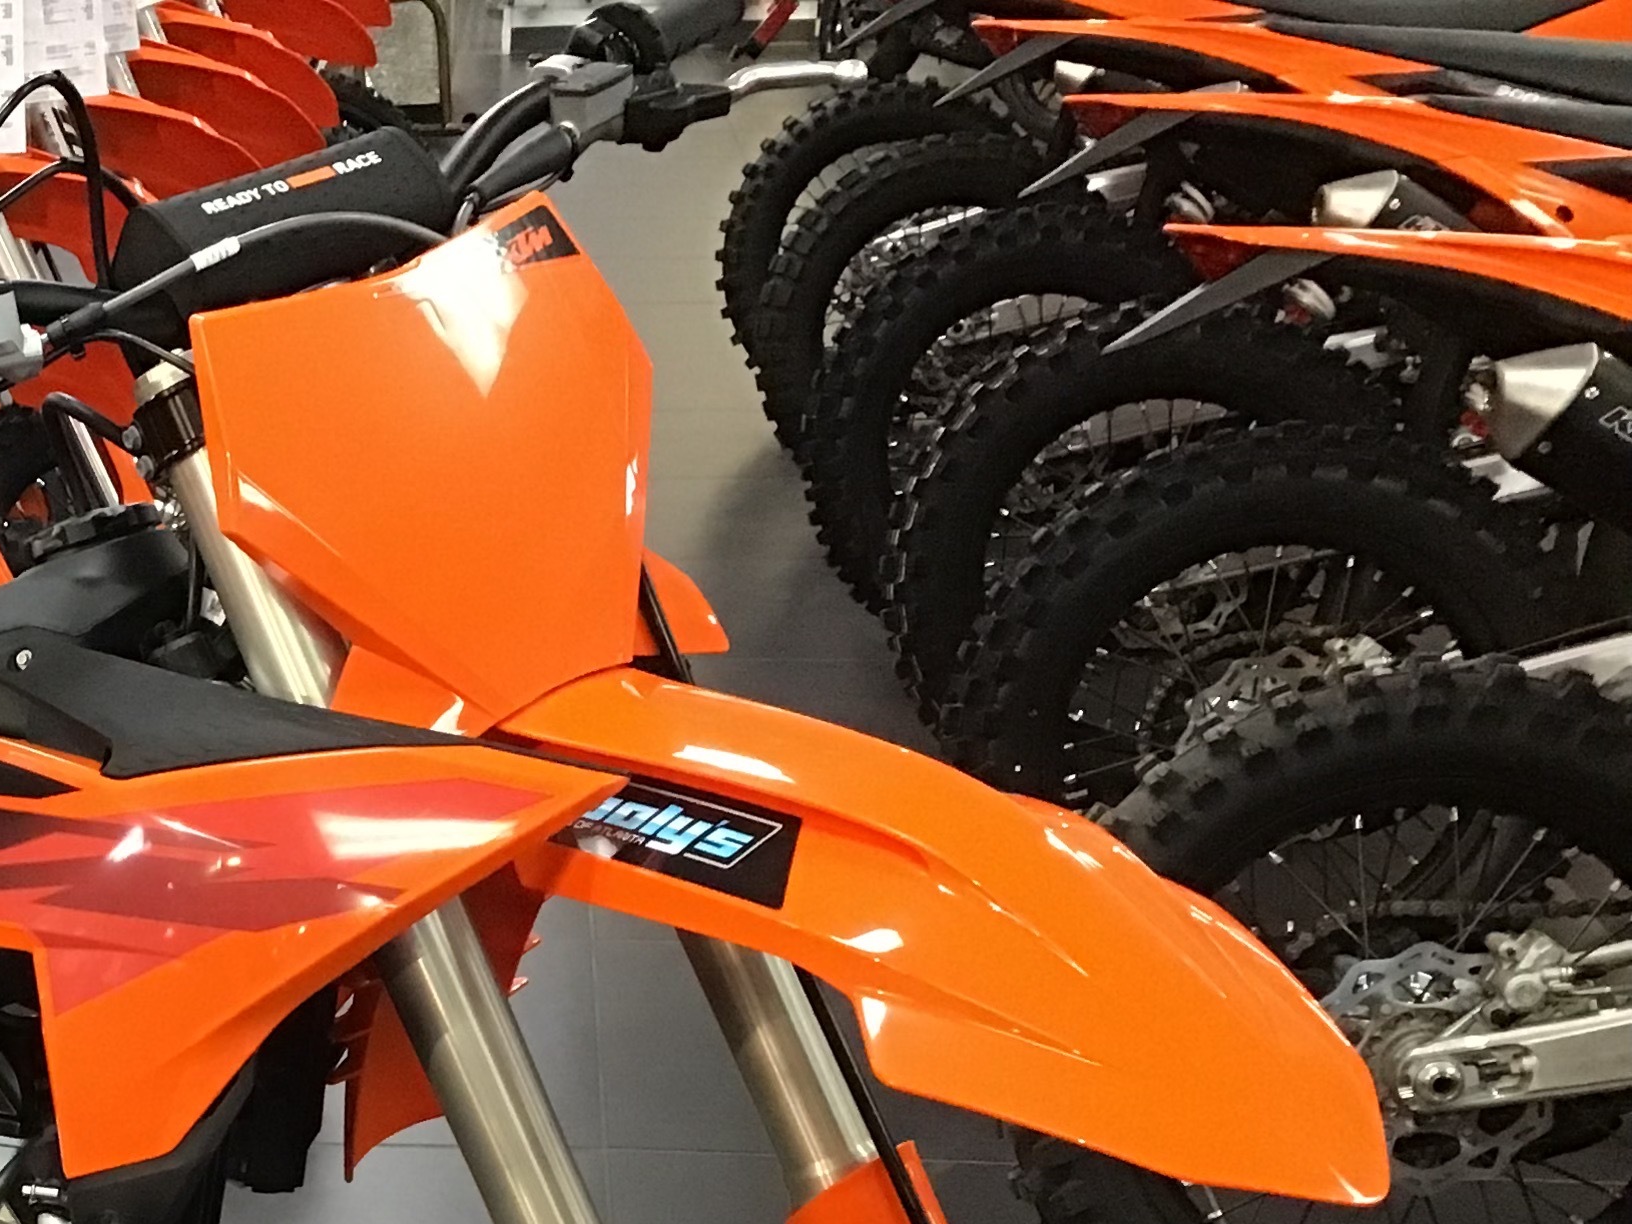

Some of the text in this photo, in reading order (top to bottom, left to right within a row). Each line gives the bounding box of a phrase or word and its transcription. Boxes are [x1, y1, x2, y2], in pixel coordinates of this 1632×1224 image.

[201, 151, 382, 214] READY TO RACE
[505, 224, 554, 263] KTM
